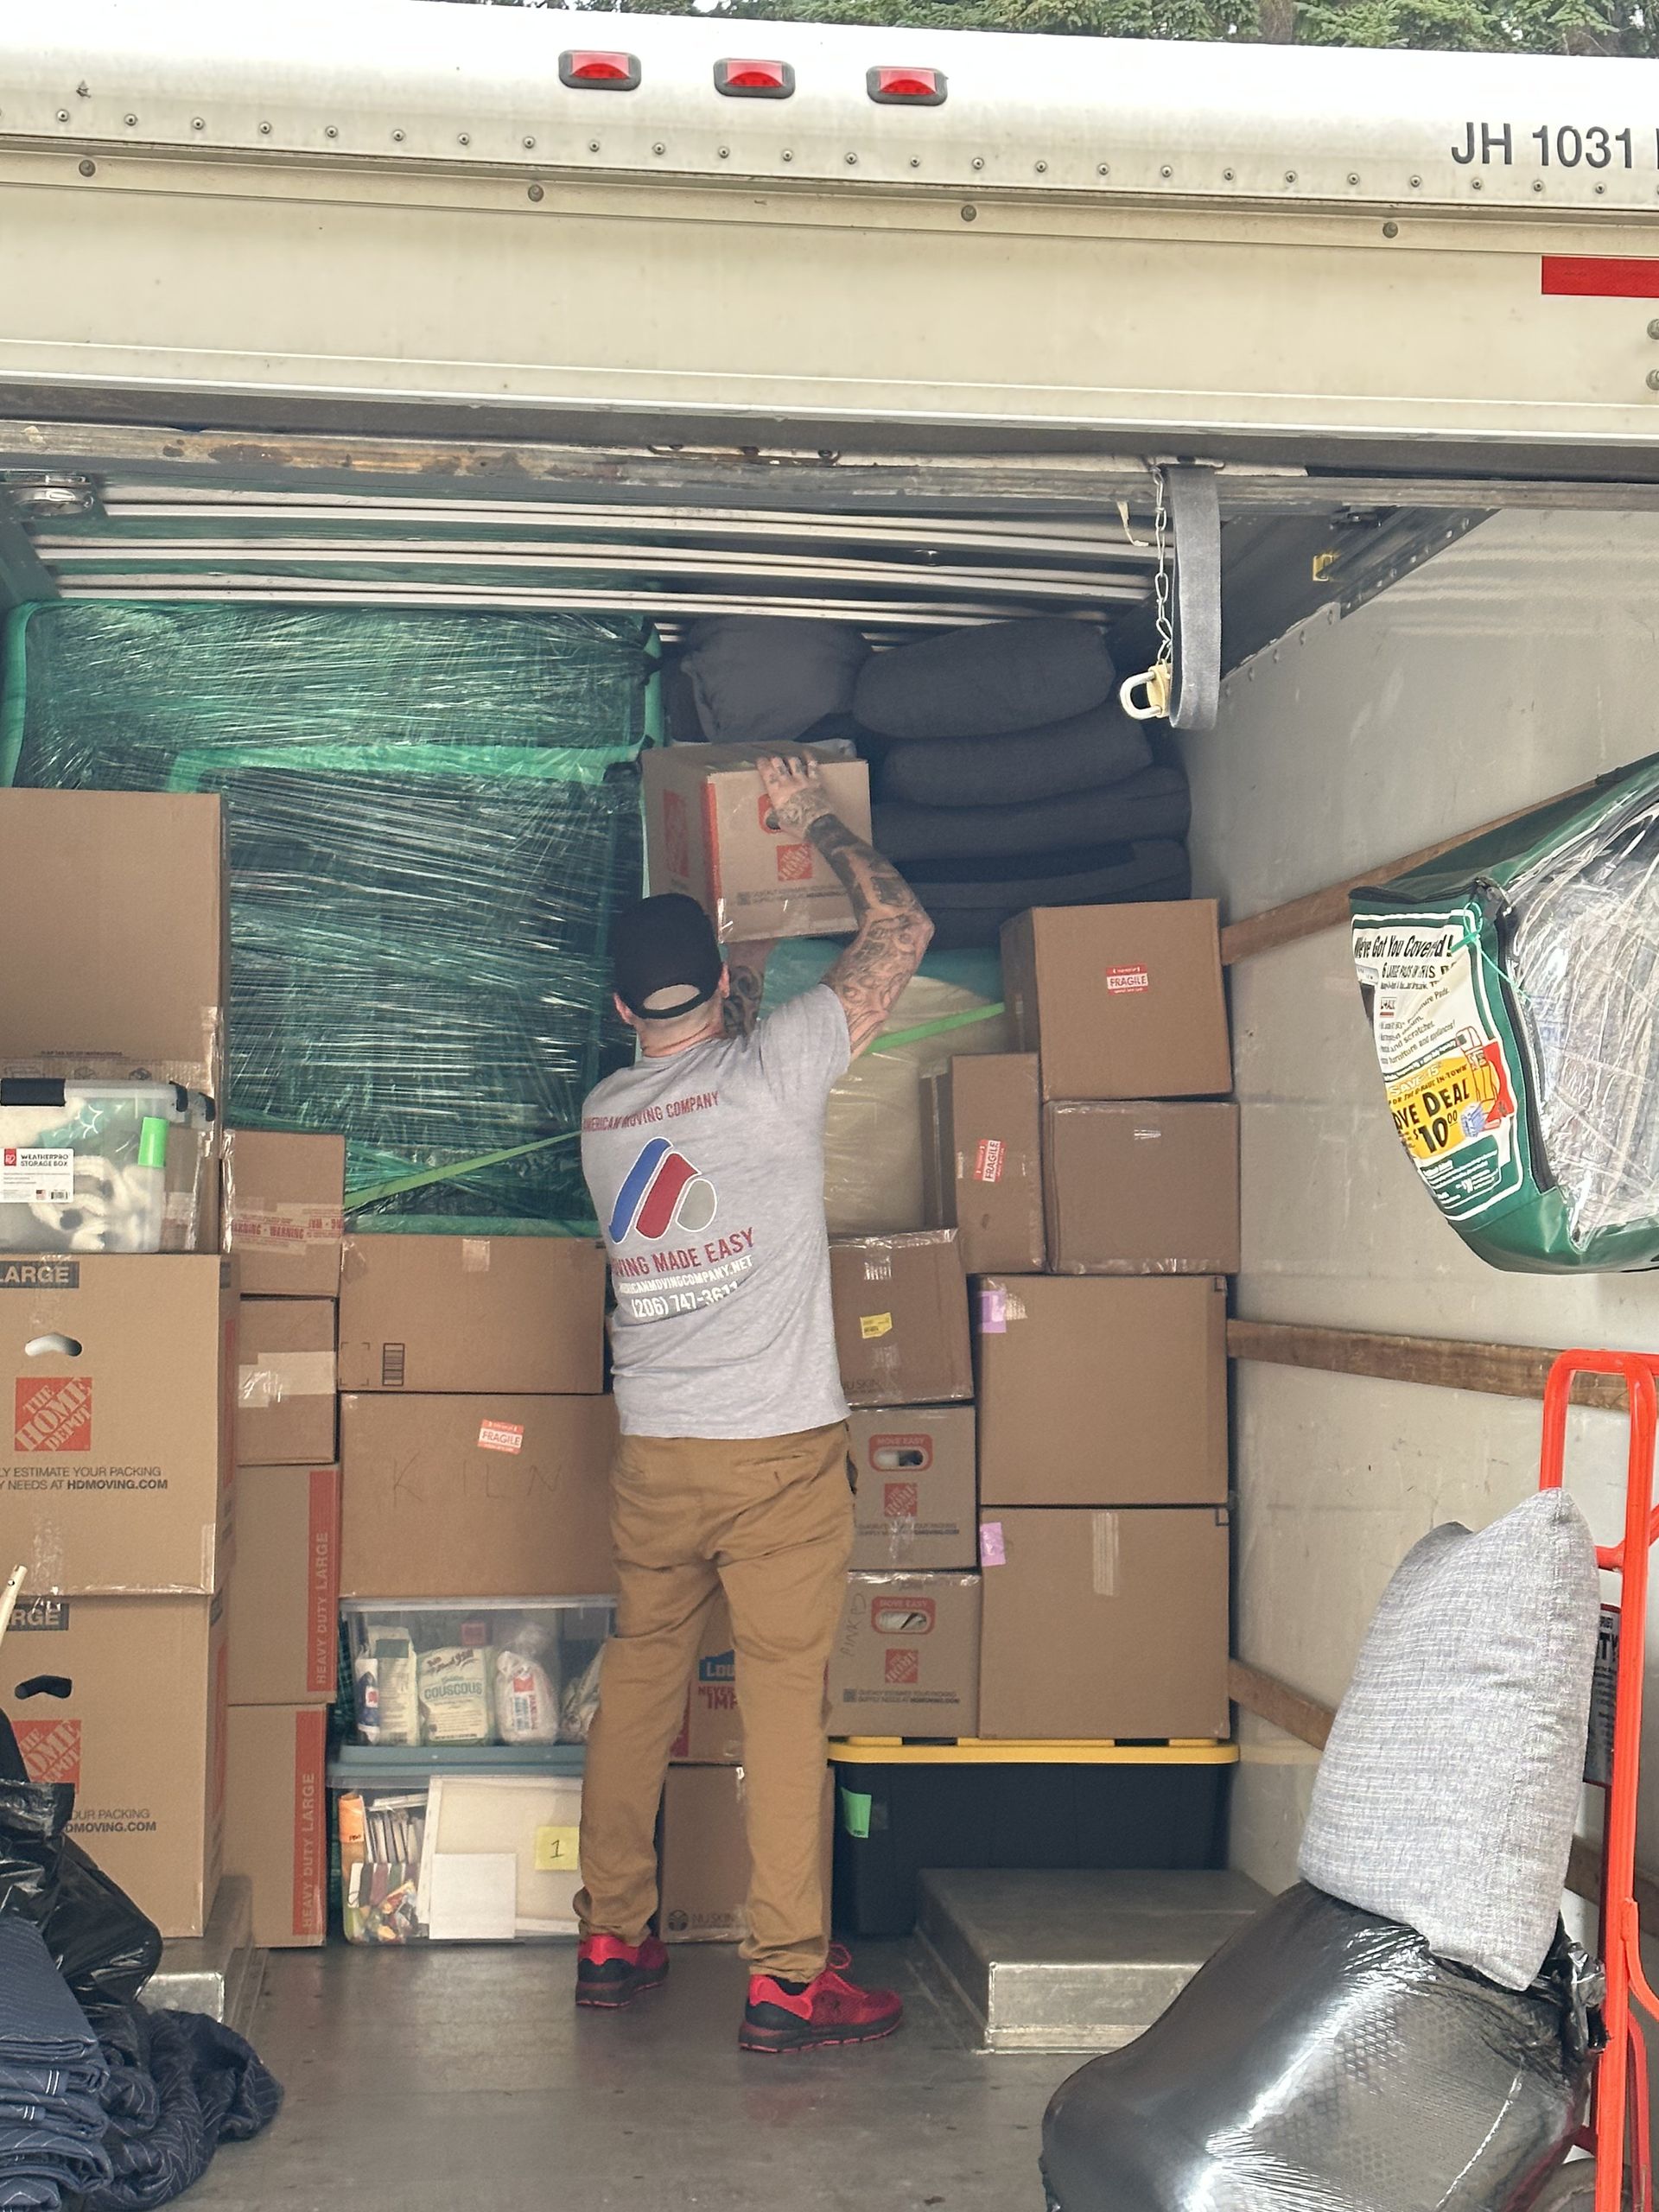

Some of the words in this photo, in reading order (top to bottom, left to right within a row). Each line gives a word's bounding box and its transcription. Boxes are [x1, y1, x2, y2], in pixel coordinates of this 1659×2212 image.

[1452, 122, 1512, 164] JH
[1532, 125, 1632, 168] 1031
[1372, 935, 1388, 957] Got
[1388, 935, 1405, 957] You
[1109, 975, 1147, 987] FRAGILE
[665, 1090, 720, 1119] COMPANY
[1422, 1077, 1471, 1118] DEAL
[985, 1141, 999, 1179] FRAGILE
[270, 1226, 304, 1240] WARNING
[652, 1248, 702, 1273] MADE
[703, 1226, 755, 1263] EASY
[0, 1266, 70, 1283] ARGE
[631, 1295, 670, 1319] (206)
[15, 1377, 92, 1452] HOME
[22, 1384, 55, 1415] THE
[44, 1403, 92, 1452] DEPOT
[482, 1430, 520, 1446] FRAGILE
[8, 1479, 48, 1491] NEEDS
[49, 1479, 65, 1491] AT
[67, 1479, 168, 1491] HDMOVING.COM
[13, 1466, 70, 1478] ESTIMATE
[73, 1466, 107, 1478] YOUR
[109, 1466, 162, 1477] PACKING
[315, 1532, 328, 1591] LARGE
[316, 1594, 328, 1632] DUTY
[315, 1634, 328, 1684] HEAVY
[423, 1681, 483, 1700] COUSCOUS
[98, 1808, 150, 1820] PACKING
[302, 1772, 315, 1832] LARGE
[302, 1839, 315, 1877] DUTY
[302, 1878, 315, 1929] HEAVY
